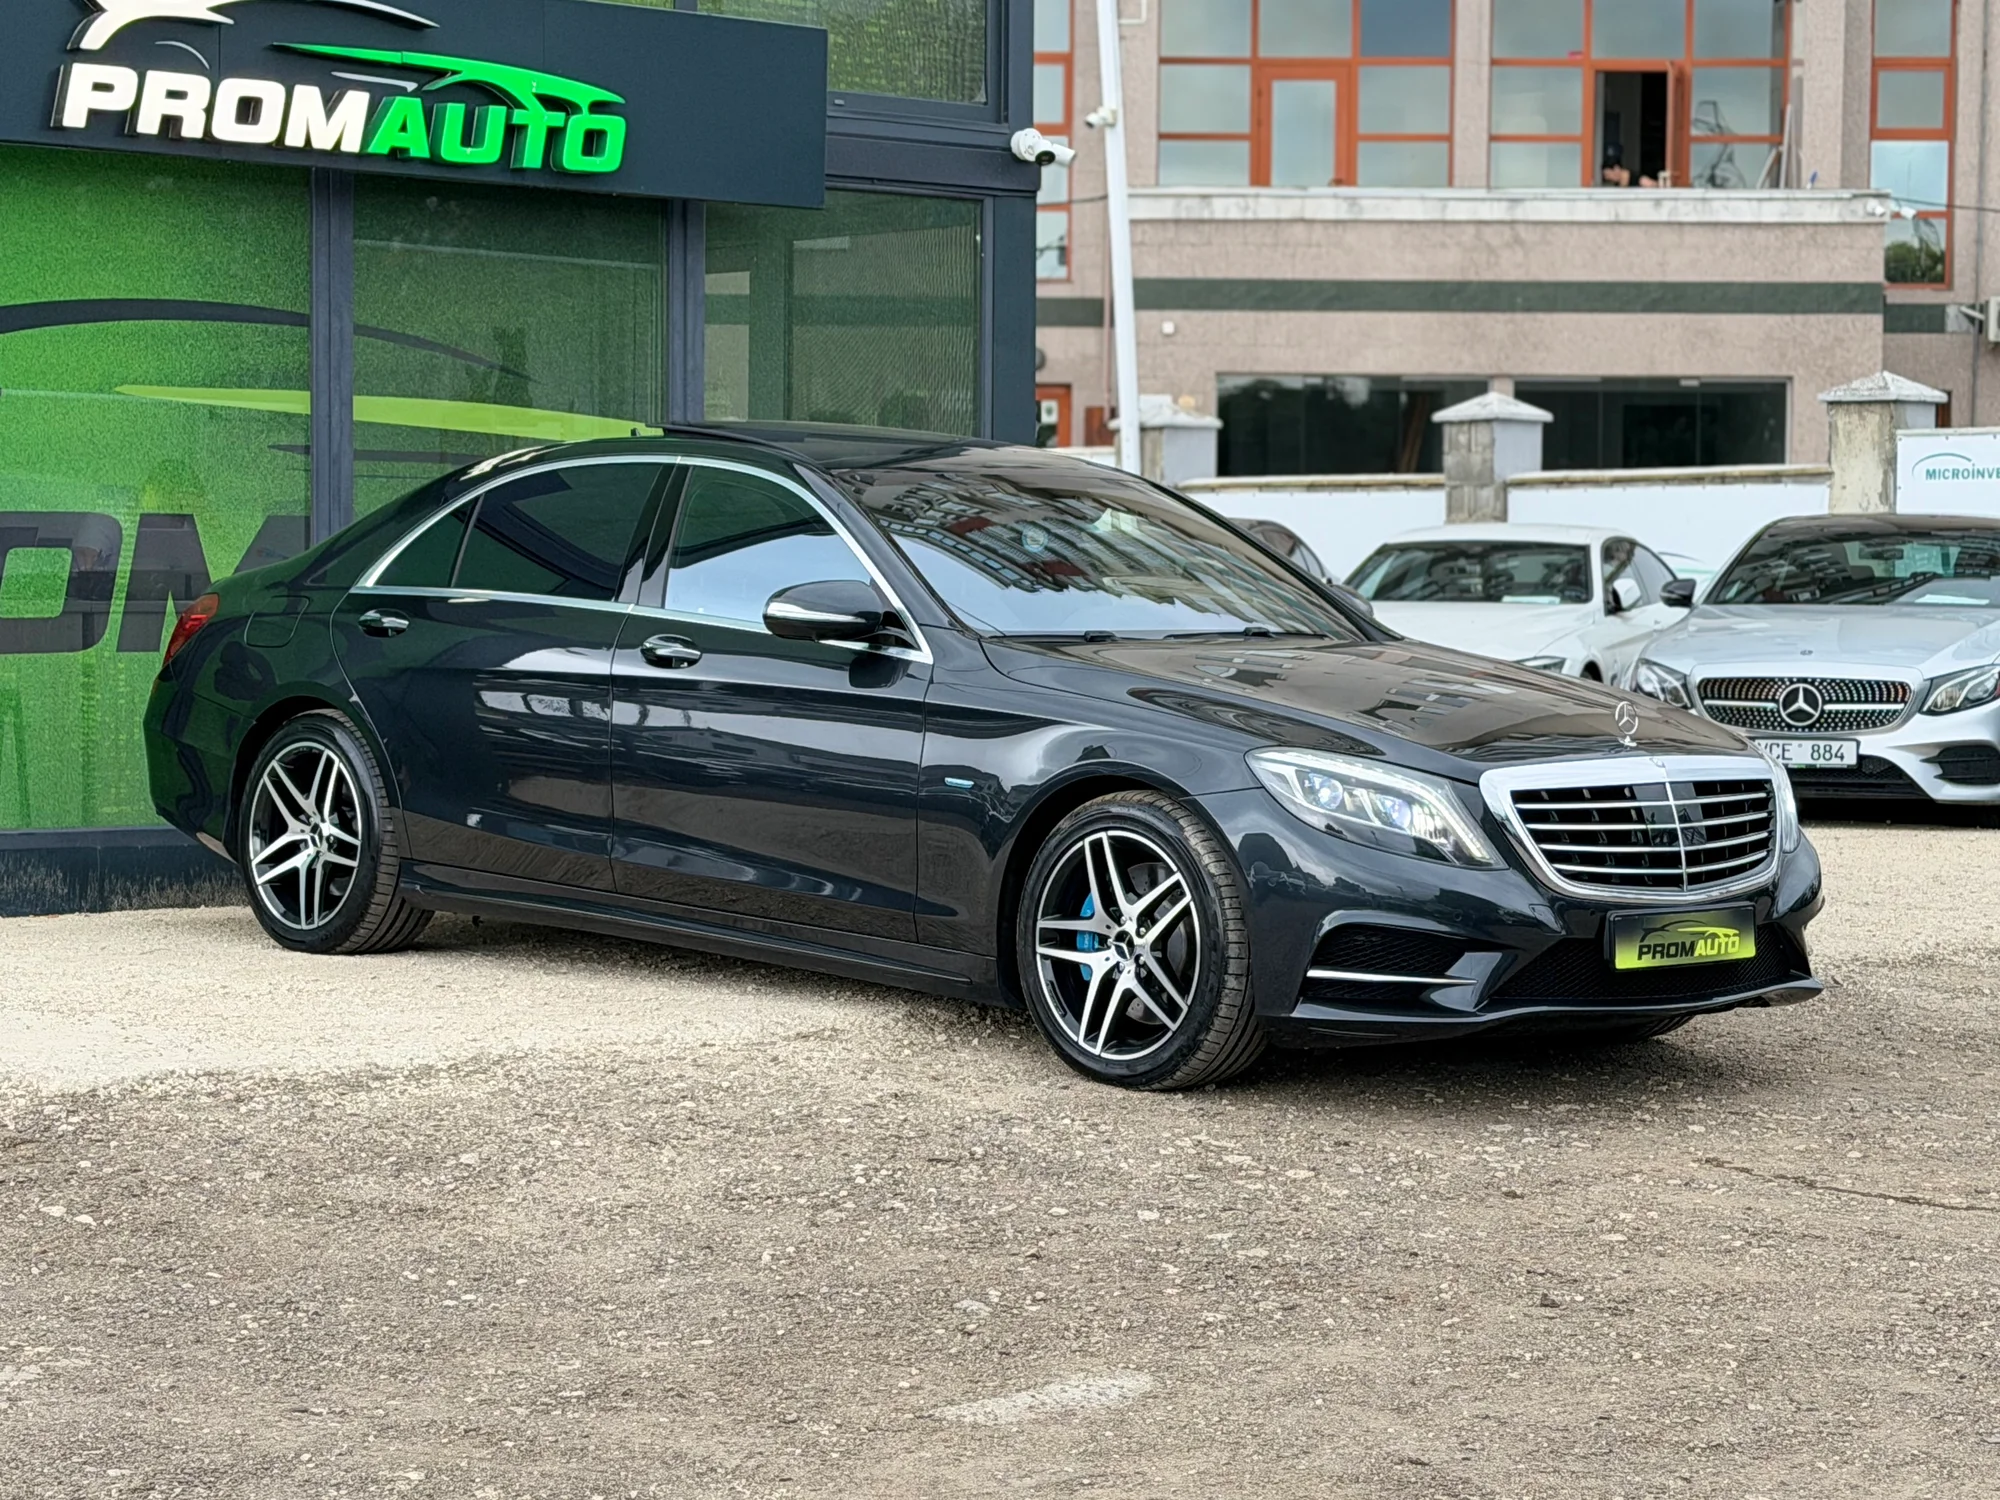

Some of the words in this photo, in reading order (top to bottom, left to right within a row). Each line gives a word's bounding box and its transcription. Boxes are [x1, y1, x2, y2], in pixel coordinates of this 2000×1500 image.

[52, 62, 627, 173] PROMAUTO
[1811, 743, 1845, 762] 884
[1637, 935, 1740, 961] PROMAUTO
